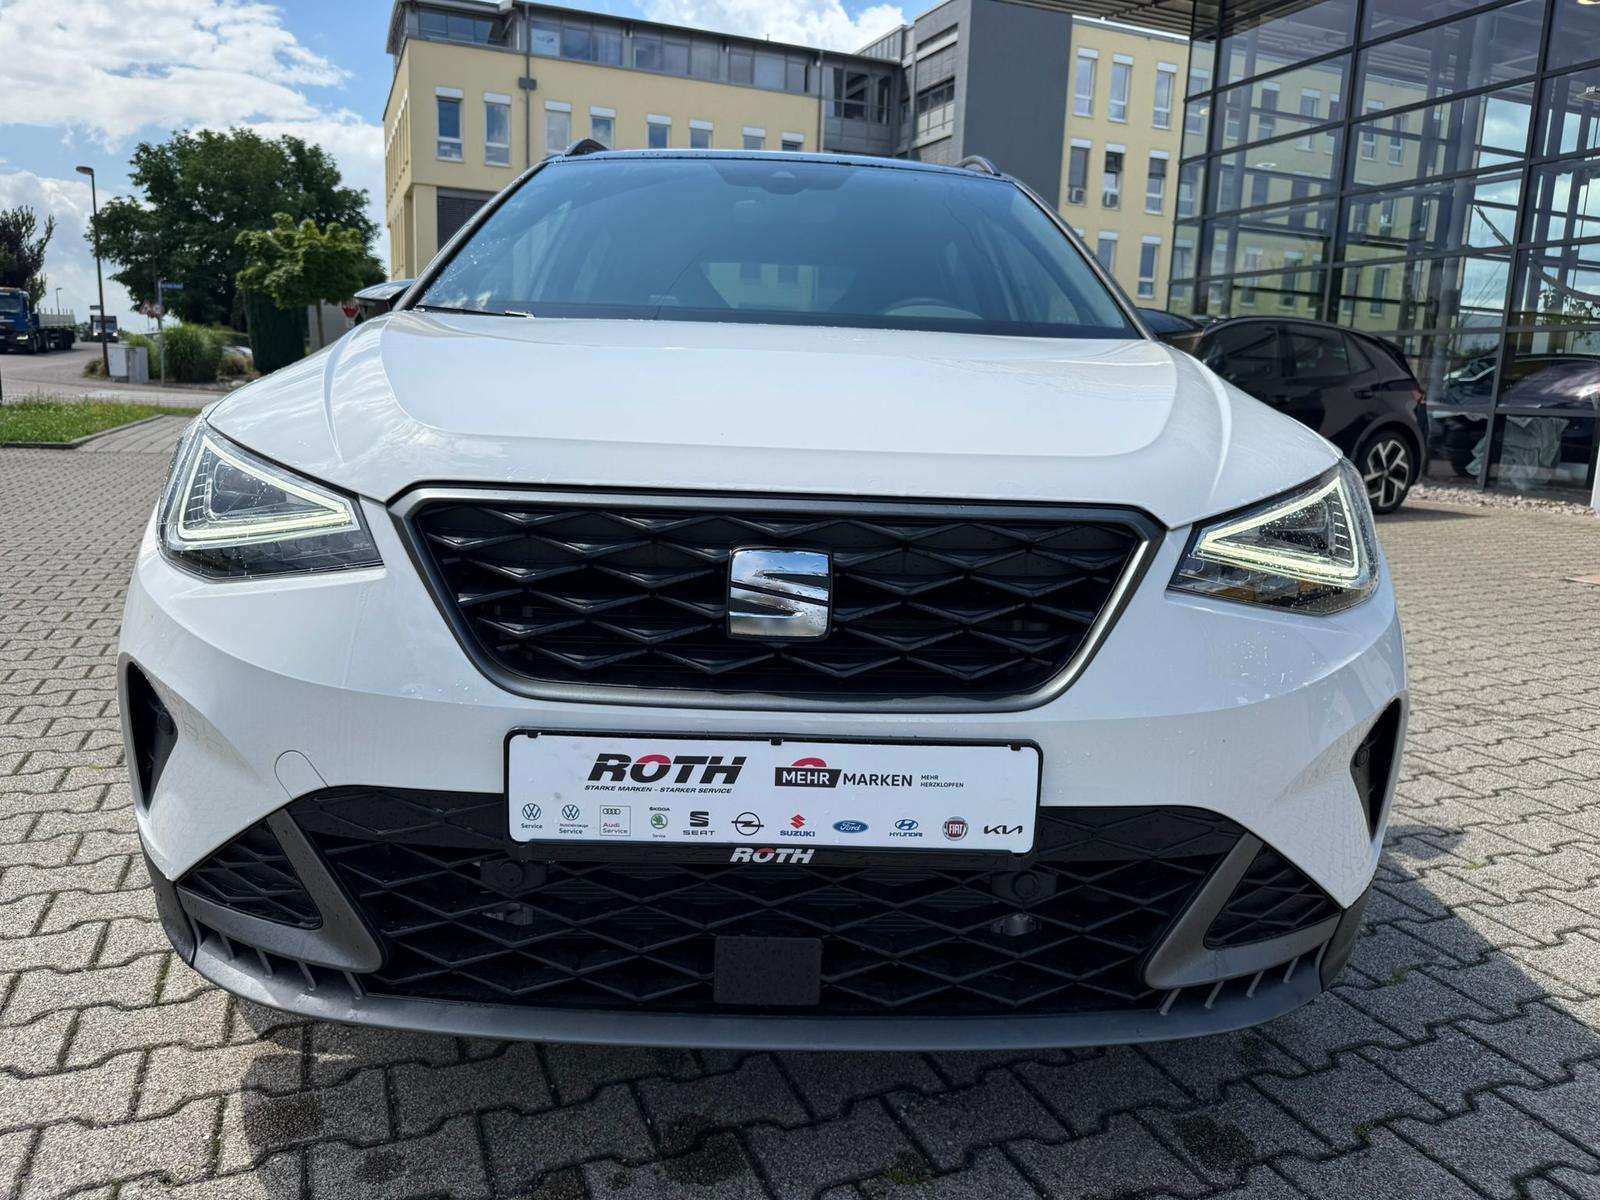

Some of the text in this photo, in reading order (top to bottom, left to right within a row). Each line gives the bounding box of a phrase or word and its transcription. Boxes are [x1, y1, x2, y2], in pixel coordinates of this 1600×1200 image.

[587, 753, 747, 784] ROTH
[782, 771, 913, 787] MEHR MARKEN
[949, 823, 963, 834] FIAT
[983, 824, 1023, 835] KIA
[729, 847, 815, 864] ROTH
